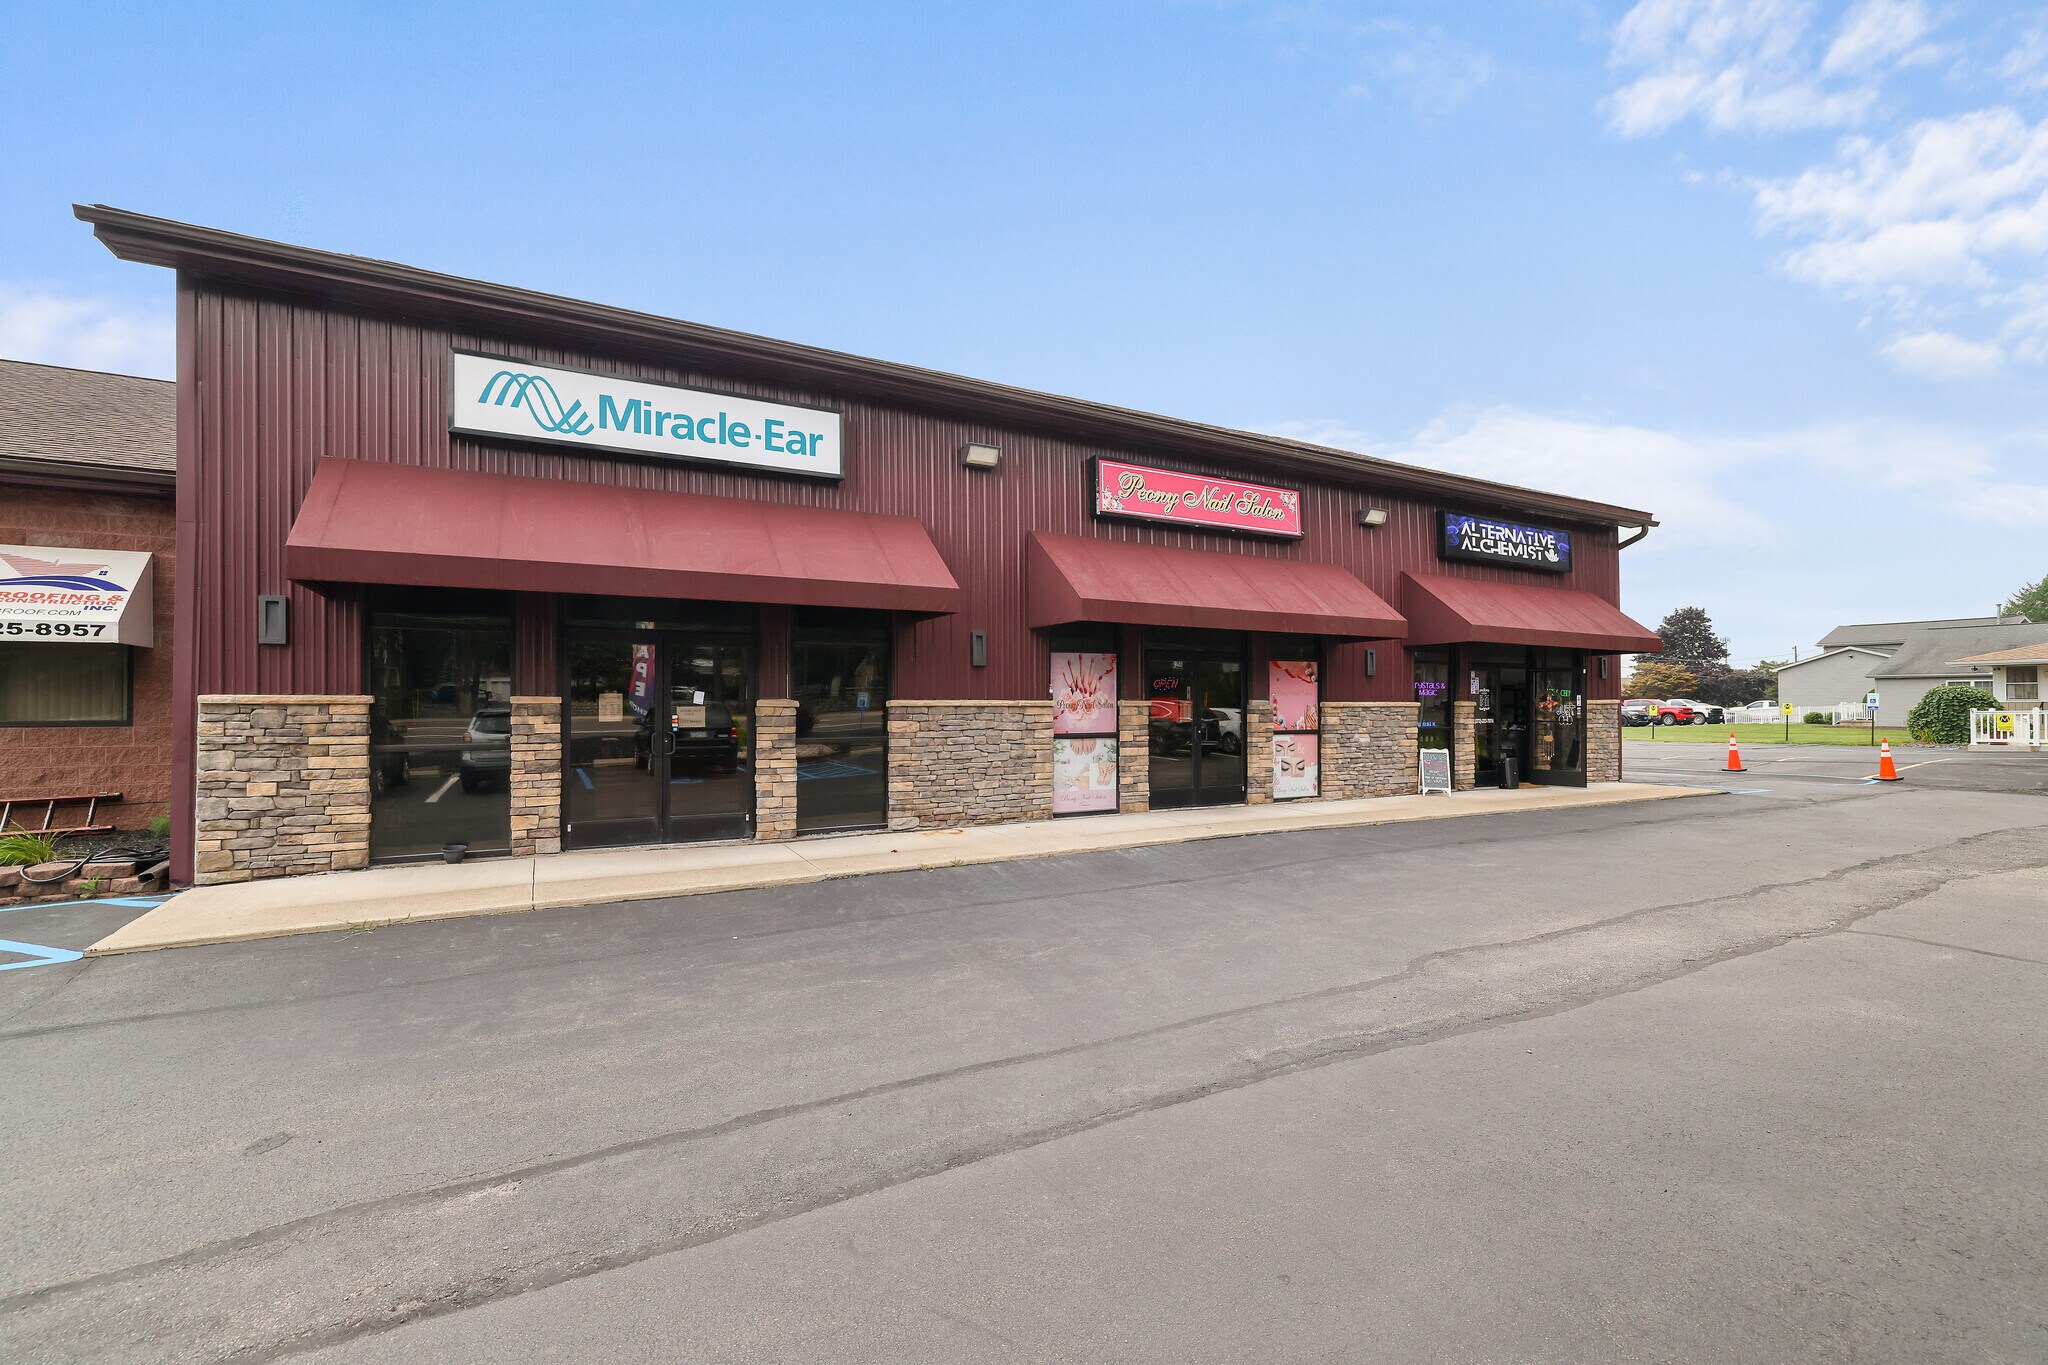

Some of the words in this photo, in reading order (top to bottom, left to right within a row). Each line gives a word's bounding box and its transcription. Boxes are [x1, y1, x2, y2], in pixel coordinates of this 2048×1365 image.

[598, 394, 824, 457] Miracle-Ear
[1118, 471, 1180, 515] Peony
[1182, 484, 1236, 513] Nail
[1235, 490, 1286, 521] Salon
[1461, 522, 1556, 549] ALTERNATIVE
[1461, 536, 1544, 560] ALCHEMIST
[107, 594, 124, 602] &
[0, 607, 82, 616] ROOF.COM
[0, 622, 106, 637] 5-8957
[1153, 678, 1179, 688] OPEN
